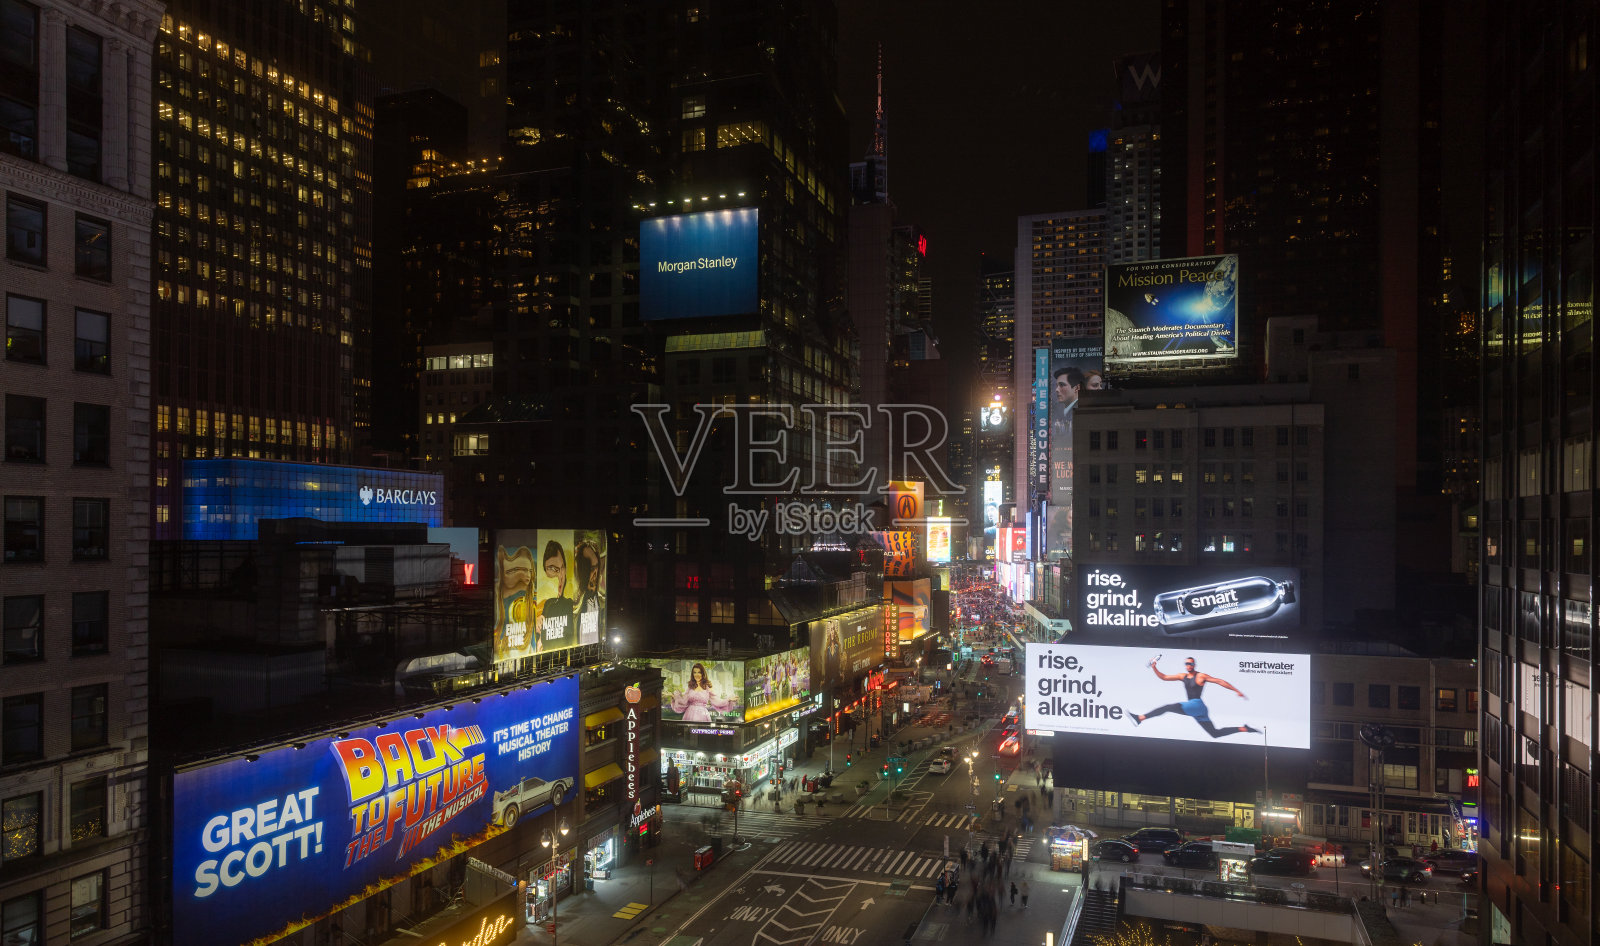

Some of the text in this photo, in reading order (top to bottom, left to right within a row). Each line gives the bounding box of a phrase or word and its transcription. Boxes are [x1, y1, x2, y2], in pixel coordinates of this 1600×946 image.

[658, 255, 738, 274] Morgan Stanley
[1161, 260, 1216, 269] CONSIDERATION
[1118, 269, 1224, 288] Mission Peace
[1184, 323, 1225, 331] Documentary
[1131, 333, 1154, 342] Healing
[1038, 356, 1048, 484] TIMES SQUARE
[1054, 462, 1065, 470] WE
[376, 488, 436, 506] BARCLAYS
[1087, 569, 1127, 589] rise,
[1086, 589, 1143, 609] grind,
[1191, 588, 1239, 609] smart
[1218, 601, 1239, 610] water
[543, 615, 568, 631] NATHAN
[1086, 608, 1160, 627] alkaline
[505, 621, 527, 637] EMMA
[844, 635, 856, 650] THE
[857, 627, 877, 645] REGIME
[1038, 650, 1084, 673] rise,
[1239, 660, 1294, 671] smartwater
[1038, 674, 1103, 698] grind,
[748, 694, 768, 708] VILLA
[1037, 696, 1123, 720] alkaline
[493, 707, 574, 744] IT'S TIME TO CHANGE
[498, 721, 569, 756] MUSICAL THEATER
[518, 739, 552, 762] HISTORY
[330, 724, 464, 804] BACK
[351, 753, 486, 844] TO FUTURE
[201, 786, 321, 854] GREAT
[421, 785, 484, 839] THE MUSICAL
[346, 827, 383, 869] THE
[193, 821, 324, 898] SCOTT!
[730, 905, 775, 922] ONLY
[821, 925, 867, 945] ONLY
